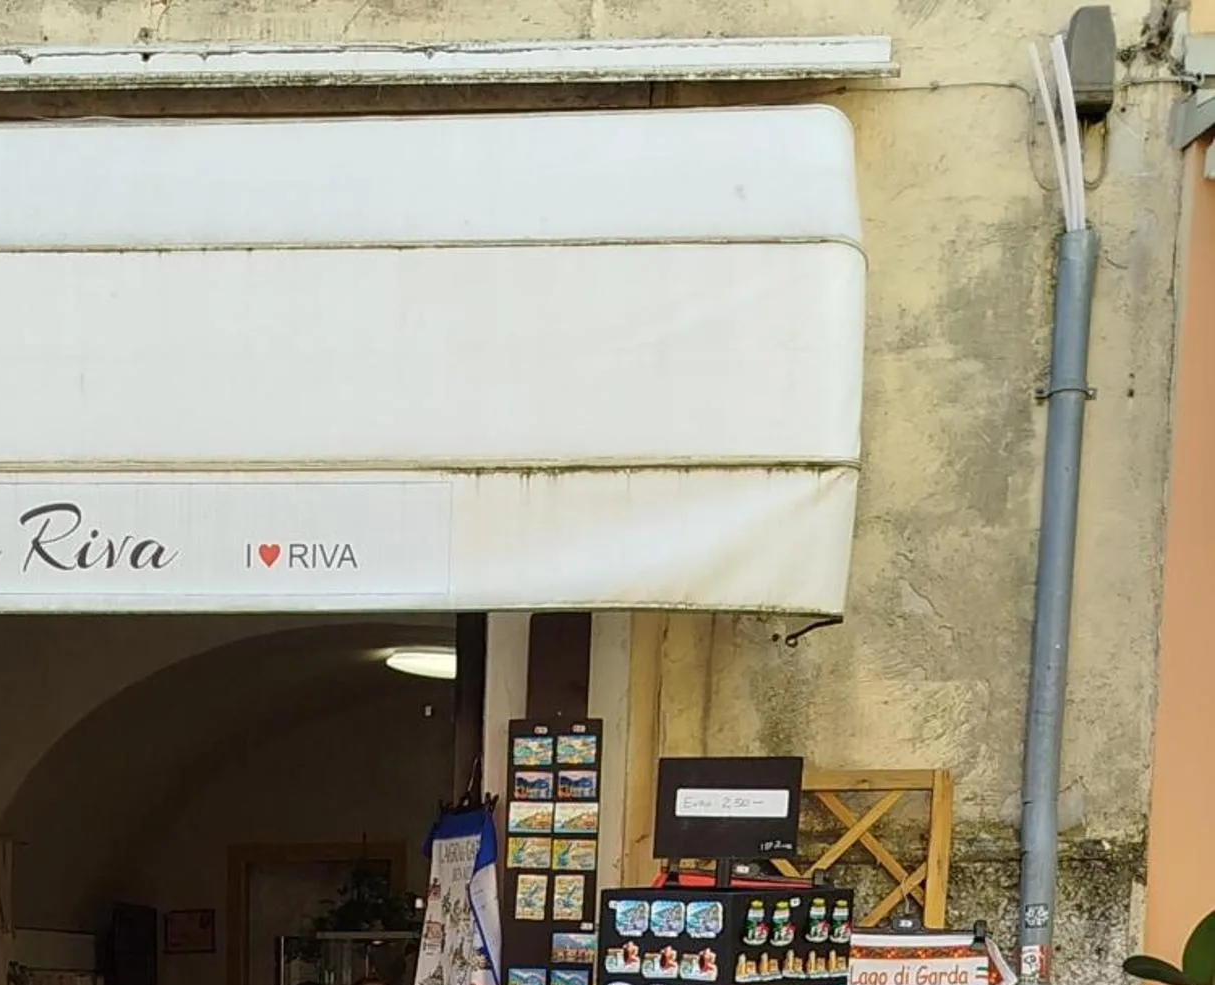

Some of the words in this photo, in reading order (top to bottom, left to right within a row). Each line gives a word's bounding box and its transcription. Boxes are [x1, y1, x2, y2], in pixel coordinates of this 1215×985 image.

[18, 502, 179, 574] Riva
[245, 543, 252, 568] I
[288, 543, 358, 569] RIVA
[893, 966, 911, 985] di
